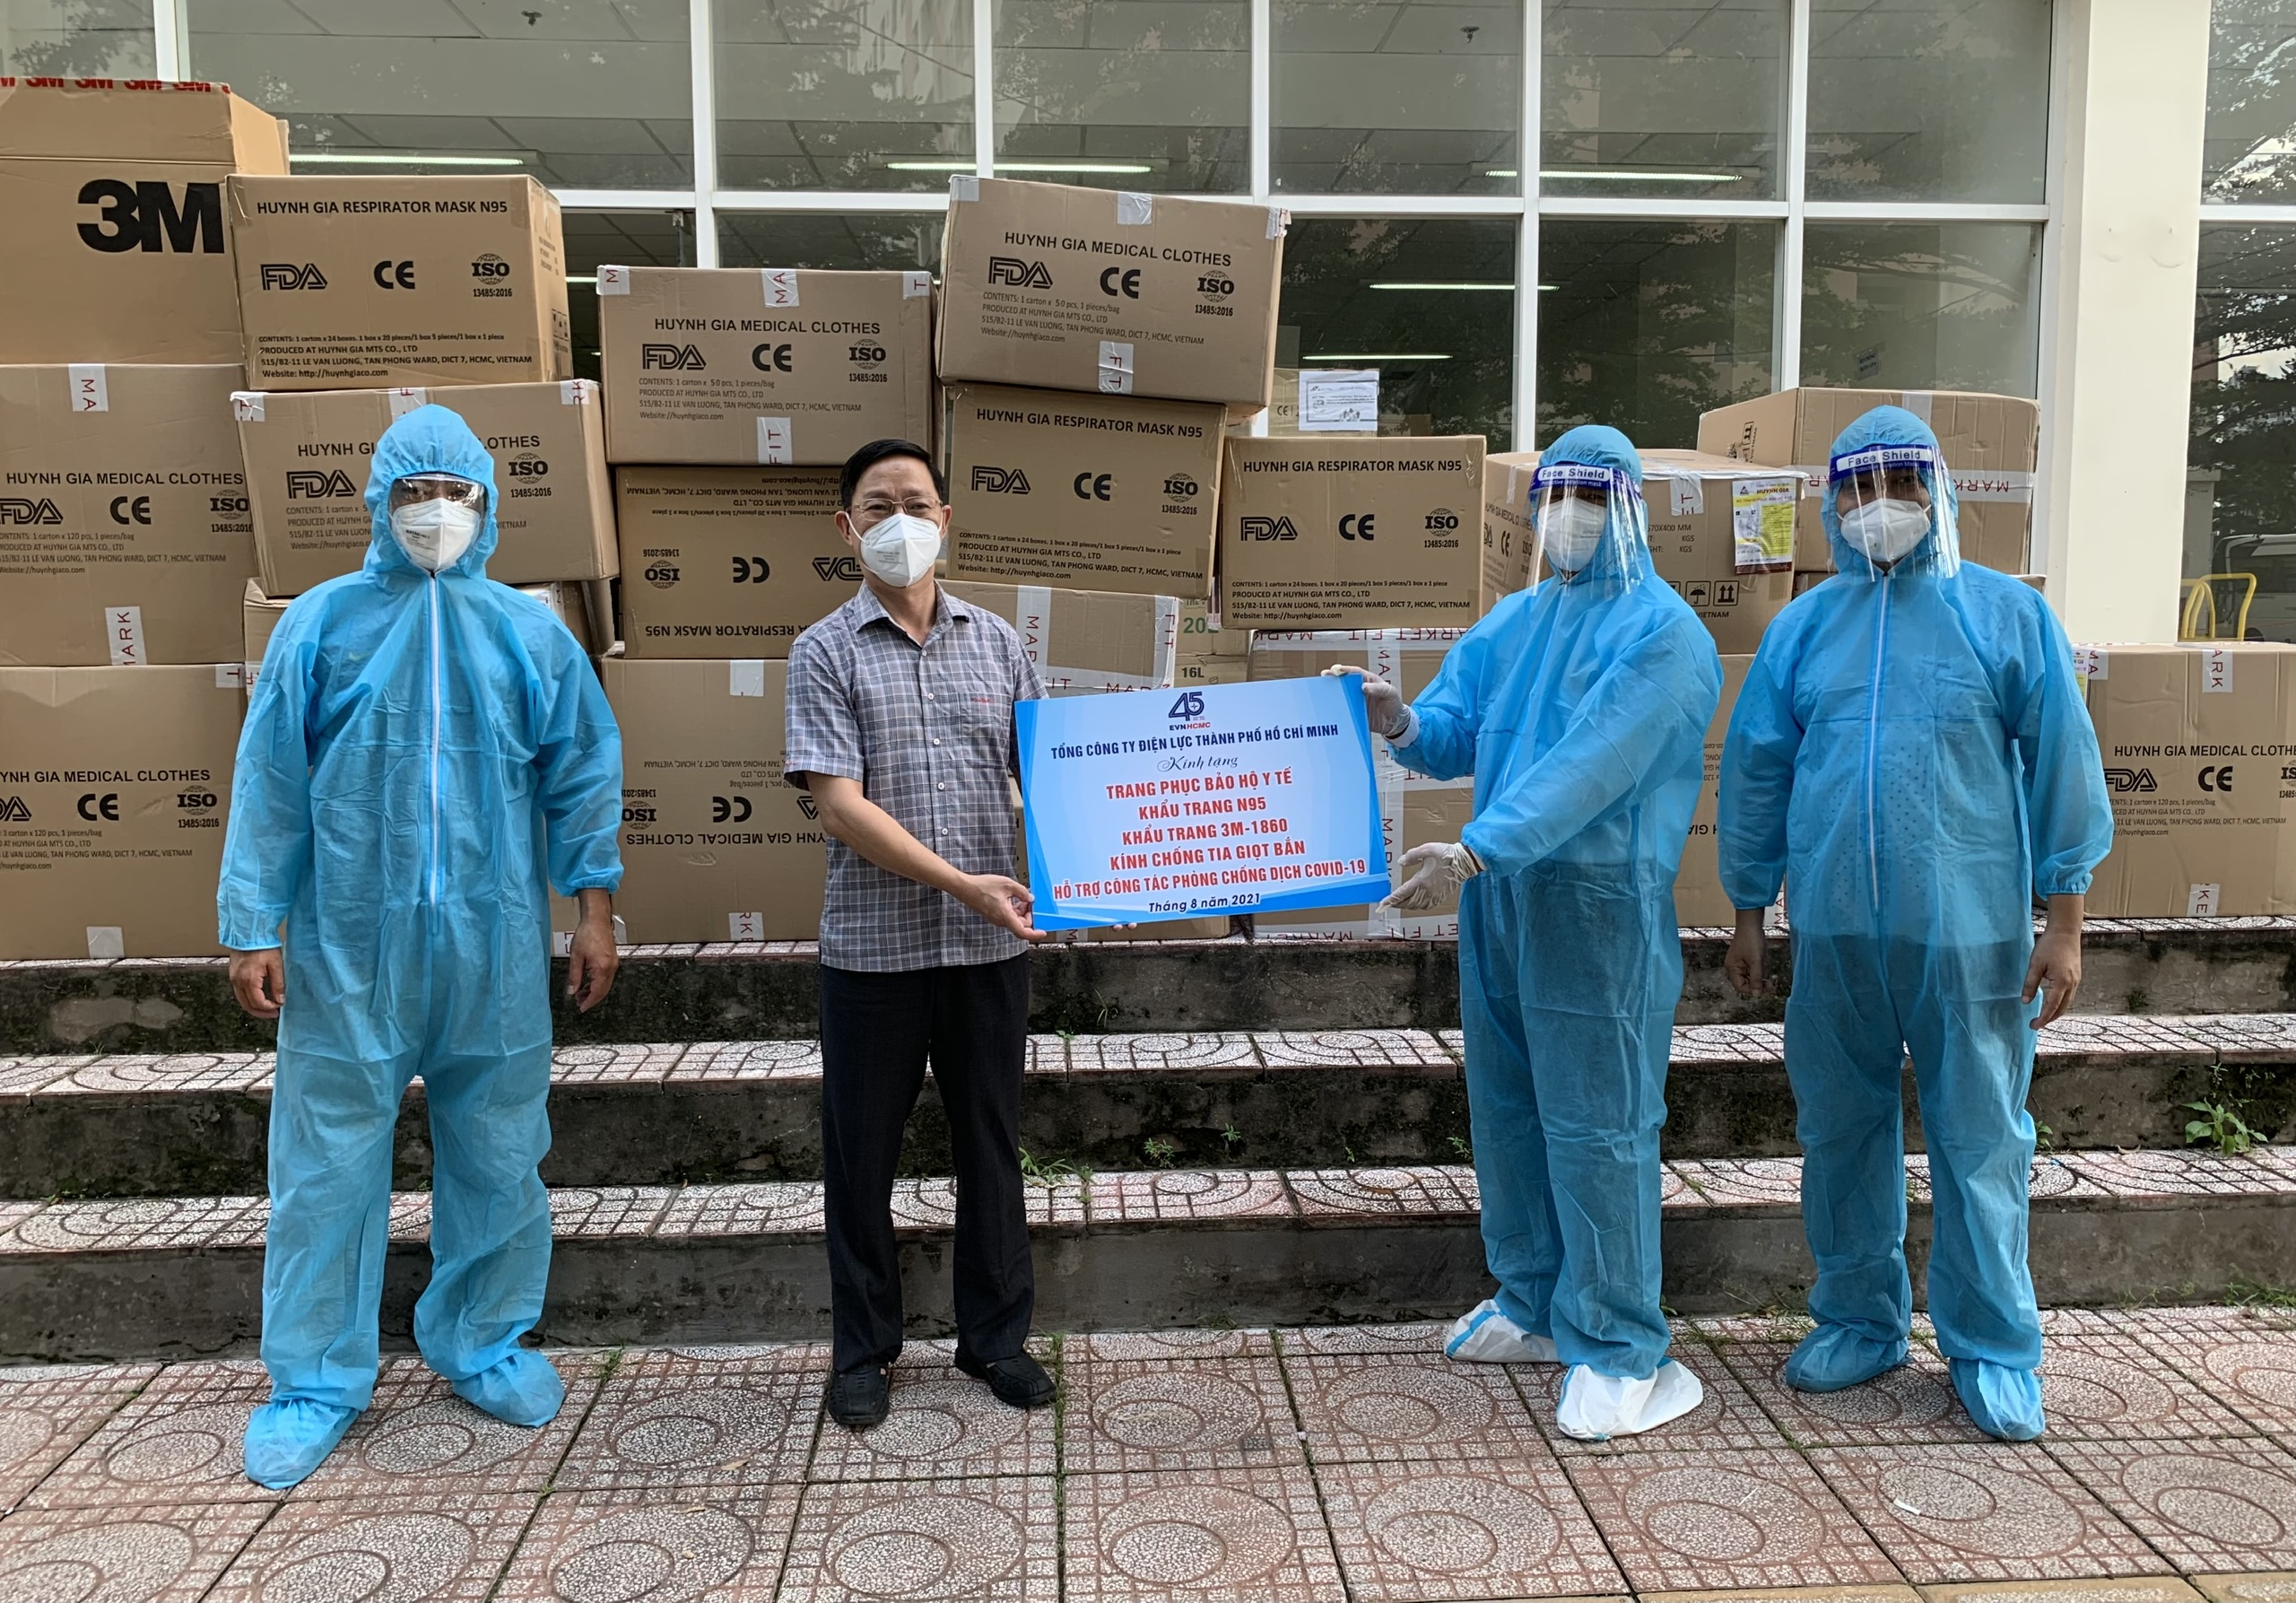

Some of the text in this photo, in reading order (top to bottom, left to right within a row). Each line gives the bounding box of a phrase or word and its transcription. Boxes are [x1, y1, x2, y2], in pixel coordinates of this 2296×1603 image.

[257, 201, 507, 213] HUYNH GIA RESPIRATOR MASK N95
[77, 179, 224, 254] 3M
[1004, 231, 1231, 266] HUYNH GIA MEDICAL CLOTHES
[260, 263, 327, 291] FDA
[374, 261, 415, 289] CE
[471, 262, 509, 277] ISO
[988, 257, 1053, 289] FDA
[1100, 266, 1141, 299] CE
[1197, 276, 1234, 295] ISO
[473, 288, 512, 298] 13485:2016
[1195, 304, 1233, 317] 13485:2016
[655, 318, 880, 334] HUYNH GIA MEDICAL CLOTHES
[642, 344, 706, 370] FDA
[752, 344, 792, 372] CE
[848, 347, 886, 362] ISO
[849, 373, 887, 383] 13485:2016
[977, 408, 1202, 438] HUYNH GIA RESPIRATOR MASK N95
[298, 443, 352, 457] HUYNH
[1243, 460, 1461, 472] HUYNH GIA RESPIRATOR MASK N95
[1848, 451, 1920, 466] Face Shield
[509, 461, 548, 476] ISO
[1543, 468, 1605, 479] Face Shield
[6, 471, 245, 484] HUYNH GIA MEDICAL CLOTHES
[286, 469, 356, 499] FDA
[971, 466, 1031, 494] FDA
[1953, 479, 2009, 492] MARK
[510, 487, 552, 498] 13485:2016
[1074, 473, 1111, 501] CE
[1163, 479, 1198, 495] ISO
[110, 496, 152, 525] CE
[1161, 504, 1197, 516] 13485:2016
[1240, 516, 1298, 541] FDA
[1338, 514, 1374, 540] CE
[1425, 516, 1458, 529] ISO
[1424, 539, 1458, 548] 13485:2016
[645, 568, 680, 581] ISO
[733, 556, 770, 583] CE
[1341, 590, 1355, 598] CO.,
[1414, 600, 1437, 608] HCMC,
[645, 624, 794, 636] RESPIRATOR MASK N95
[1182, 667, 1205, 677] 16L
[1169, 692, 1205, 721] 45
[1170, 722, 1211, 731] EVNHCMC
[1050, 724, 1337, 759] TỔNG CÔNG TY ĐIỆN LỰC THÀNH PHỐ HỒ CHÍ MINH
[2114, 745, 2247, 756] HUYNH GIA MEDICAL
[1157, 755, 1204, 772] Kính
[34, 769, 210, 782] GIA MEDICAL CLOTHES
[1106, 766, 1292, 798] TRANG PHỤC BẢO HỘ Y TẾ
[2198, 766, 2232, 791] CE
[77, 793, 118, 821] CE
[178, 794, 217, 807] ISO
[1138, 797, 1265, 819] KHẨU TRANG N95
[713, 796, 752, 823] CE
[178, 818, 219, 828] 13485:2016
[626, 832, 791, 844] GIA MEDICAL CLOTHES
[1122, 818, 1287, 845] KHẨU TRANG 3M-1860
[1109, 839, 1305, 870] KÍNH CHỐNG TIA GIỌT BẮN
[1054, 858, 1364, 899] HỖ TRỢ CÔNG TÁC PHÒNG CHỐNG DỊCH COVID-19
[1149, 893, 1259, 912] Tháng 8 năm 2021
